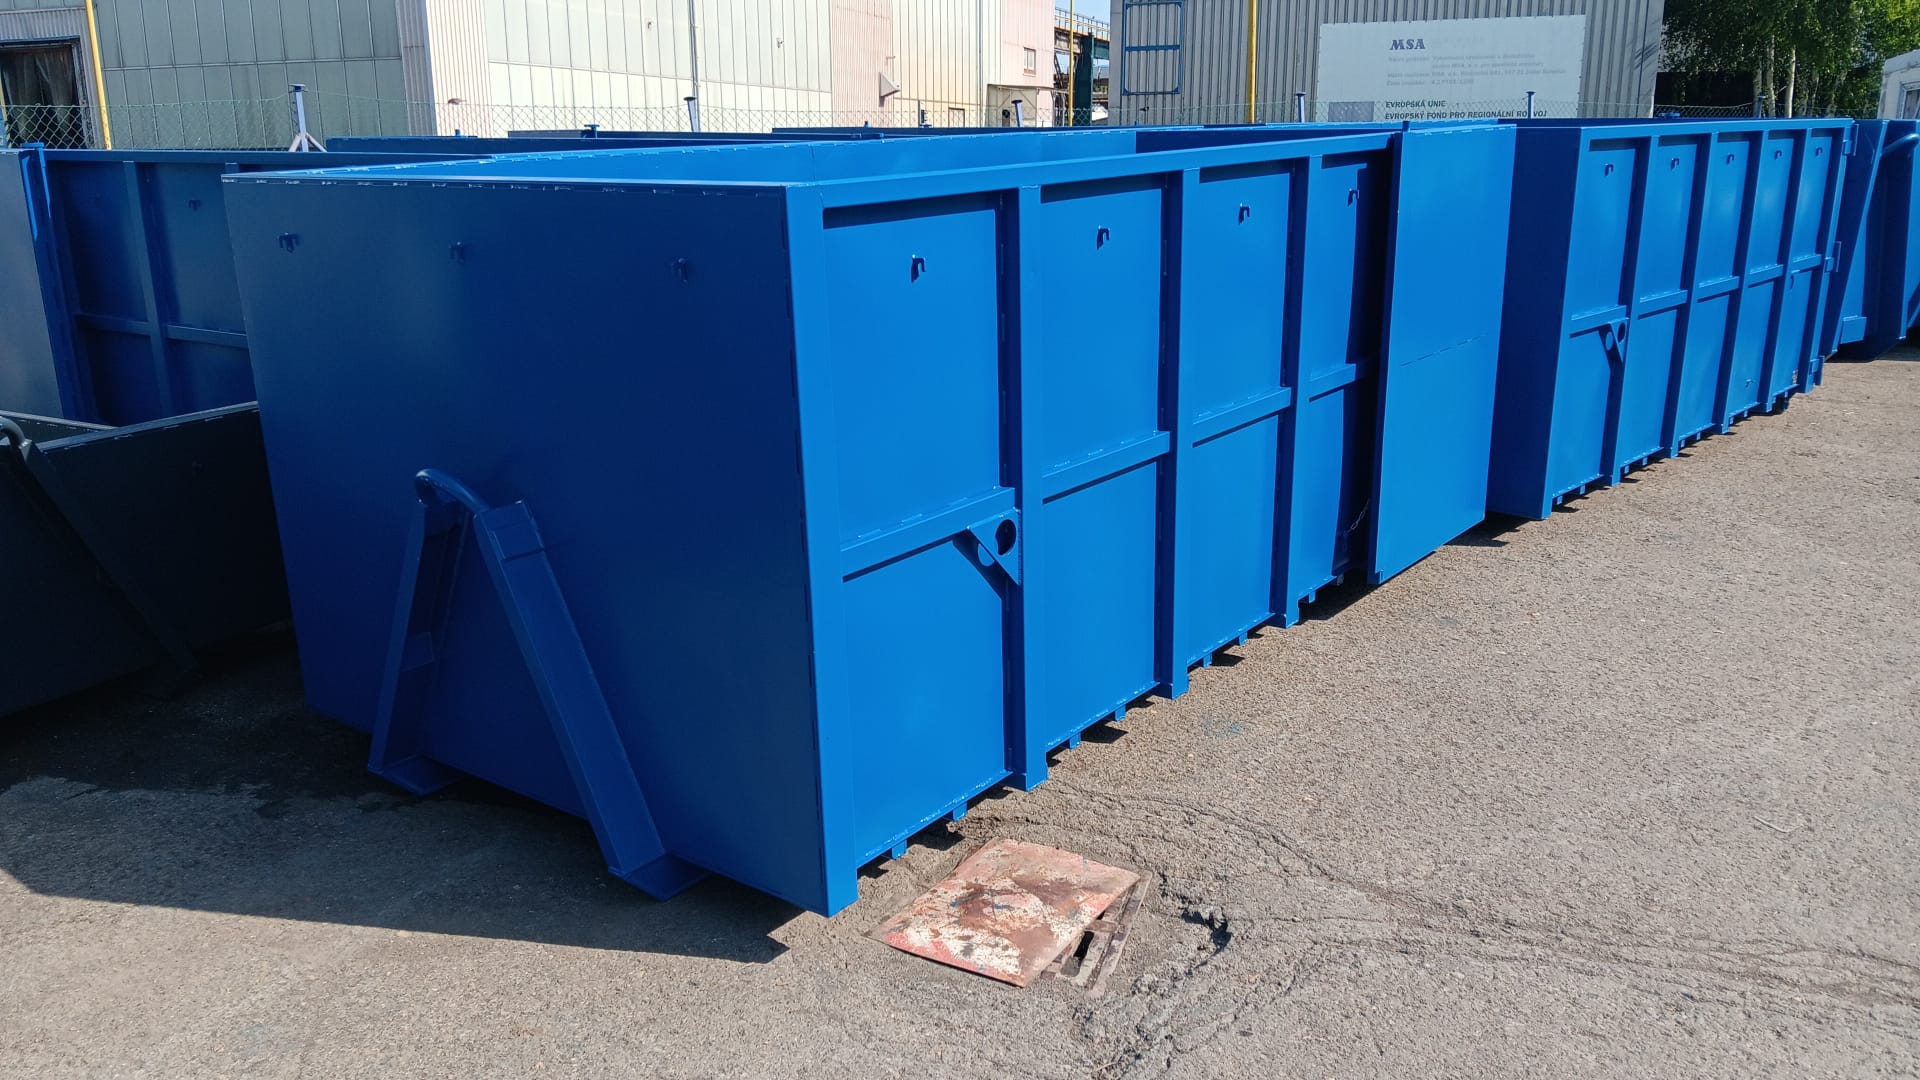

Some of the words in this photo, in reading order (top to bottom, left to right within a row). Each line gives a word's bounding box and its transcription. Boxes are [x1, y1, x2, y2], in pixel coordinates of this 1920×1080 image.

[1389, 39, 1426, 50] MSA
[1386, 99, 1426, 108] EVROPSKÁ
[1428, 100, 1447, 108] UNIE
[1385, 110, 1424, 120] EVROPSKÝ
[1427, 112, 1447, 120] FOND
[1450, 111, 1466, 119] PRO
[1468, 109, 1515, 118] REGIONÁLNÍ
[1517, 110, 1547, 118] ROVOJ
